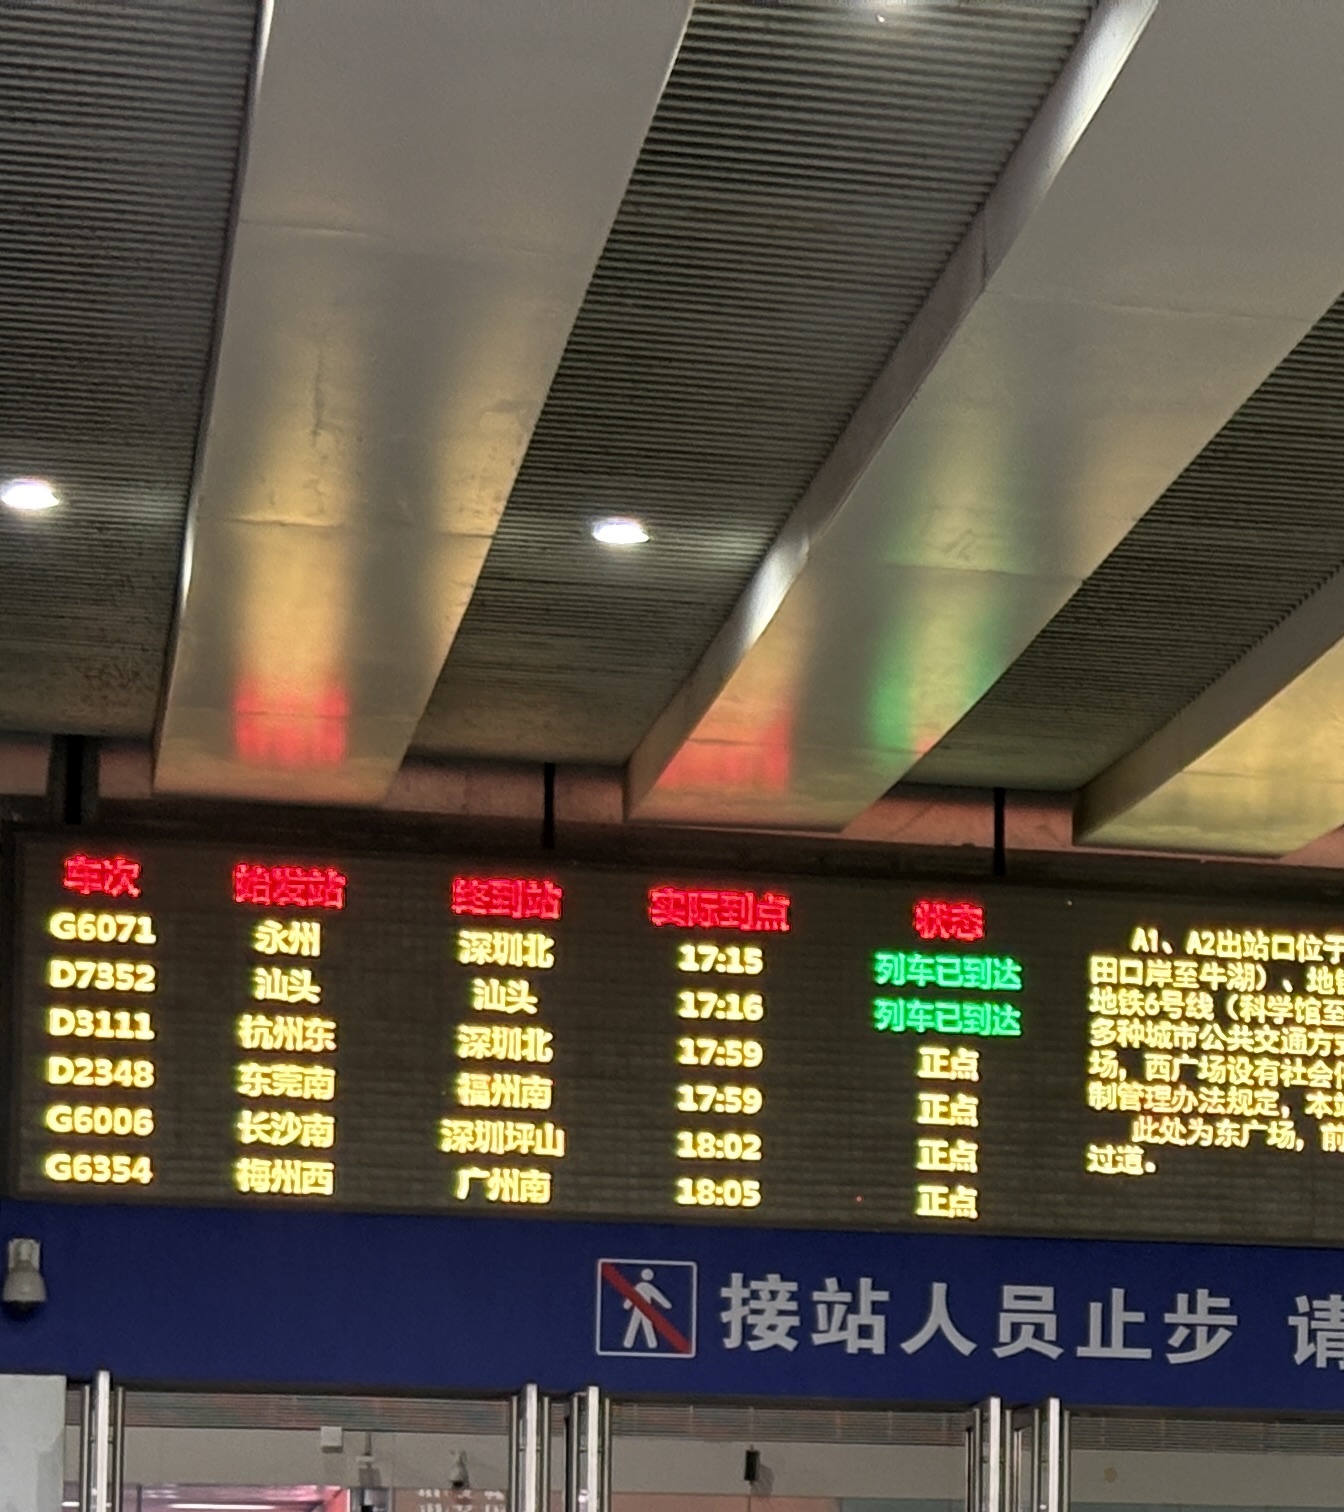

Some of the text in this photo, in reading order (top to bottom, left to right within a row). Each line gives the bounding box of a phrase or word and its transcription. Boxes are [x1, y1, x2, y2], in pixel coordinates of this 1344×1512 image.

[63, 855, 141, 896] 车次
[233, 863, 348, 909] 始发站
[451, 876, 563, 919] 终到站
[648, 887, 791, 932] 实际到点
[49, 912, 156, 944] G6071
[913, 899, 985, 941] 状态
[254, 921, 322, 957] 永州
[457, 931, 555, 968] 深圳北
[49, 960, 156, 992] D7352
[677, 943, 764, 975] 17:15
[871, 951, 1024, 992] 列车已到达
[253, 968, 321, 1003] 汕头
[472, 979, 538, 1014] 汕头
[48, 1008, 155, 1040] D3111
[677, 991, 764, 1022] 17:16
[871, 997, 1023, 1037] 列车已到达
[238, 1015, 337, 1052] 杭州东
[457, 1026, 554, 1063] 深圳北
[676, 1037, 764, 1069] 17:59
[916, 1045, 980, 1083] 正点
[47, 1056, 155, 1088] D2348
[237, 1063, 336, 1101] 东莞南
[457, 1073, 553, 1110] 福州南
[676, 1084, 763, 1115] 17:59
[46, 1105, 154, 1136] G6006
[915, 1092, 979, 1128] 正点
[236, 1110, 335, 1149] 长沙南
[439, 1120, 565, 1158] 深圳坪山
[676, 1131, 762, 1161] 18:02
[45, 1153, 153, 1185] G6354
[915, 1138, 979, 1174] 正点
[234, 1158, 335, 1197] 梅州西
[456, 1167, 551, 1203] 广州南
[675, 1178, 761, 1208] 18:05
[914, 1184, 978, 1219] 正点
[720, 1271, 1239, 1364] 接站人员止步
